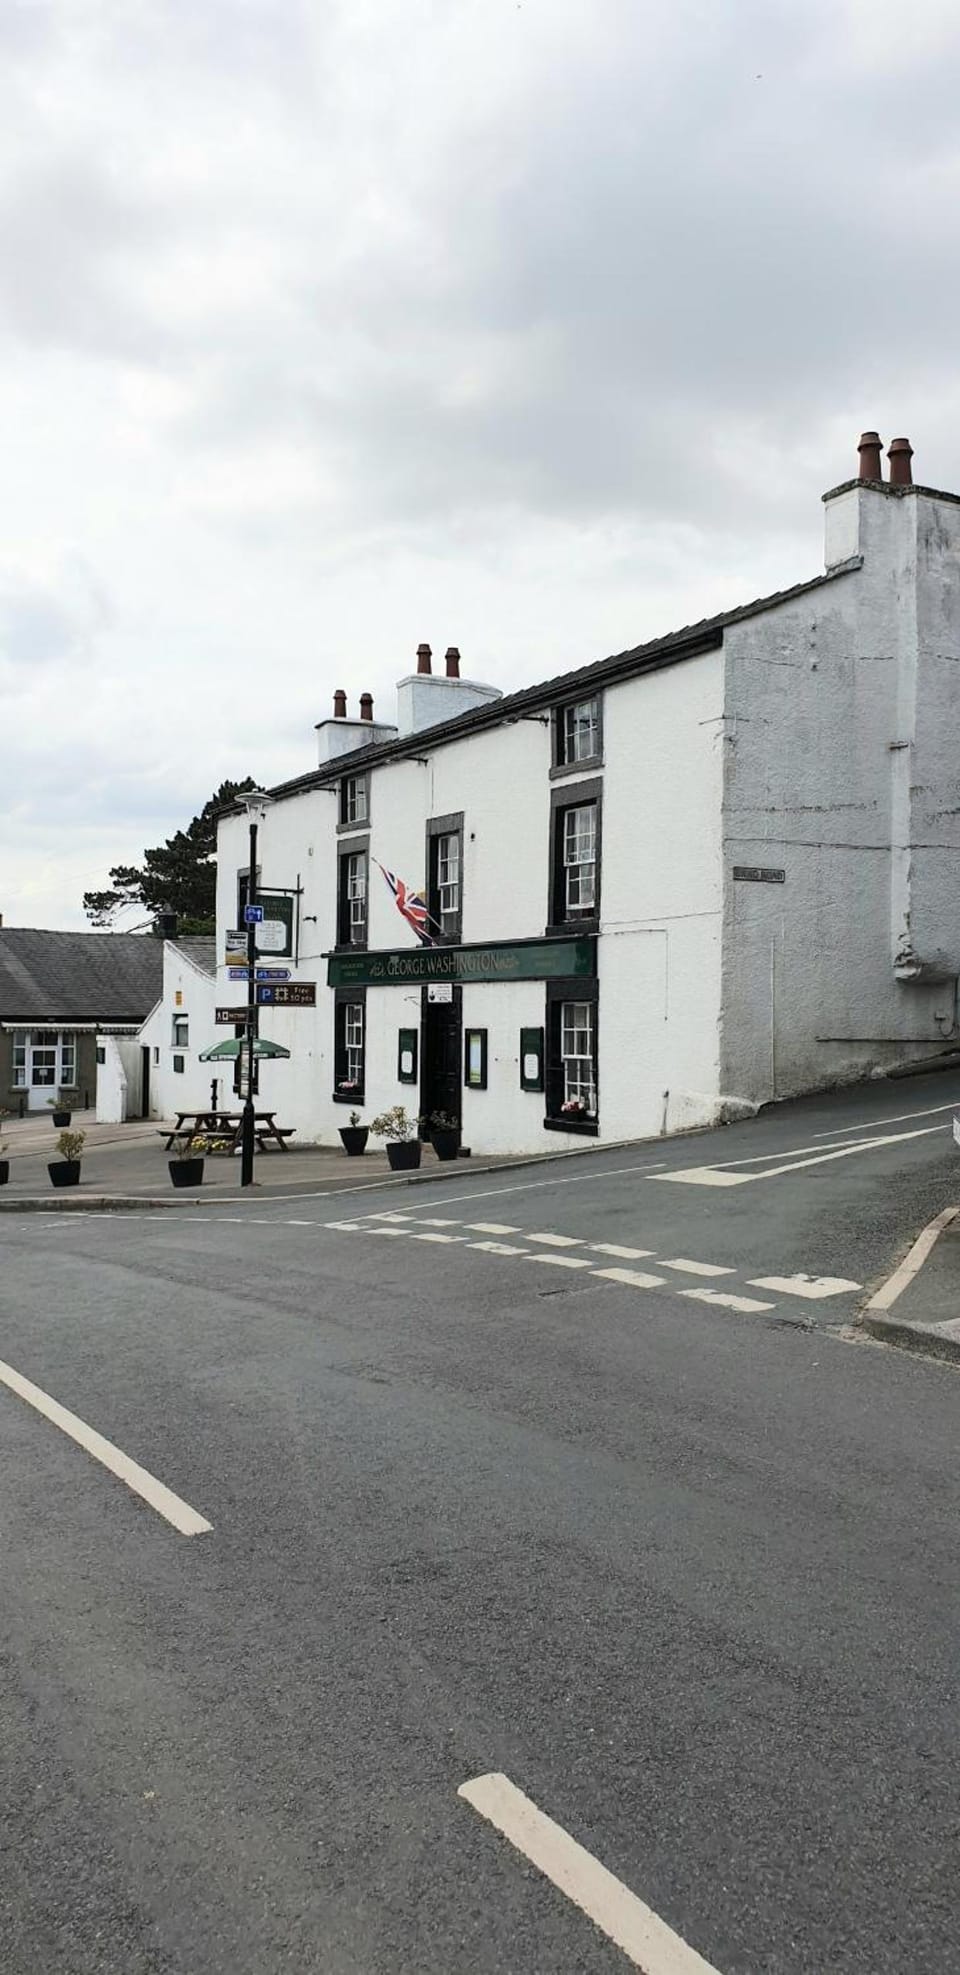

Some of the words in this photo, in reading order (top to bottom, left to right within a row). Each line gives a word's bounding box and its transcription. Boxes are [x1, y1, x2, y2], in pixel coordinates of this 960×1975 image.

[387, 958, 425, 976] GEORGE
[426, 951, 498, 974] WASHINGTON
[262, 988, 271, 1000] P
